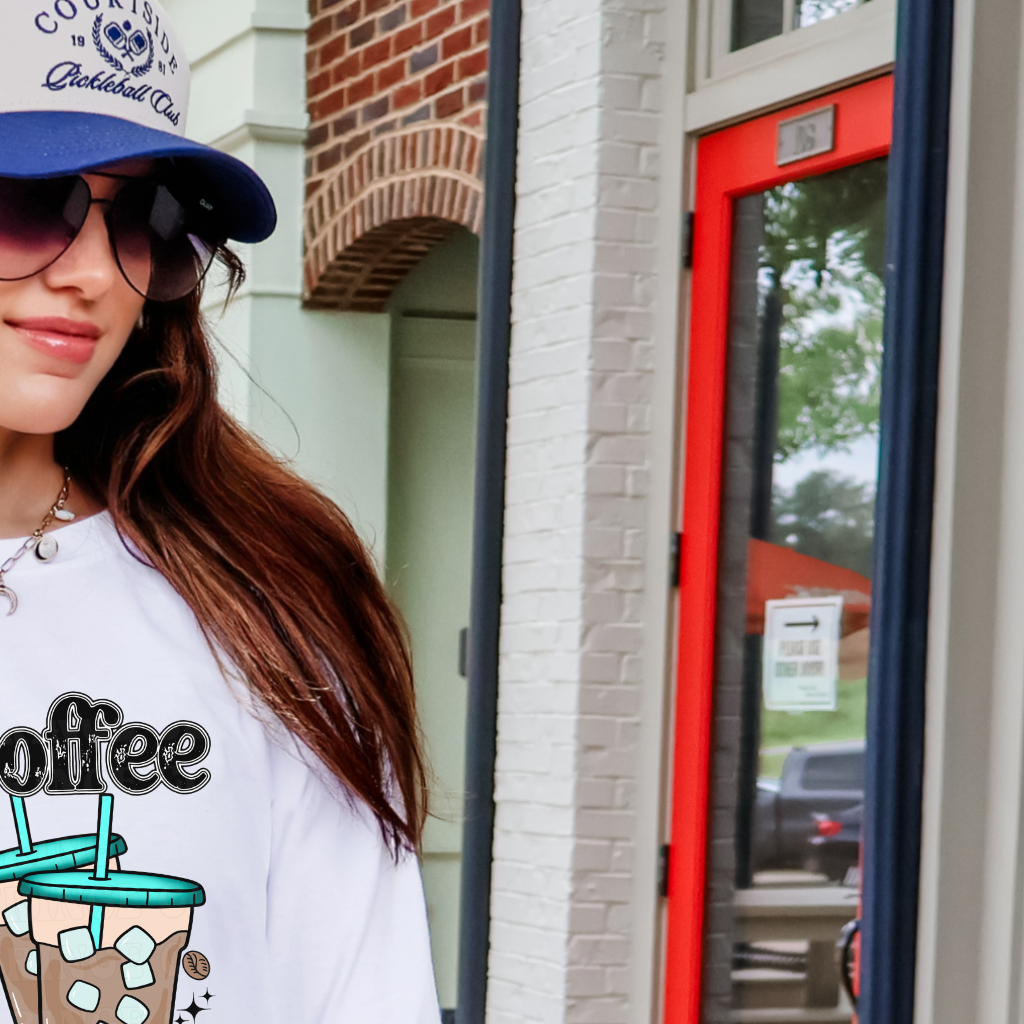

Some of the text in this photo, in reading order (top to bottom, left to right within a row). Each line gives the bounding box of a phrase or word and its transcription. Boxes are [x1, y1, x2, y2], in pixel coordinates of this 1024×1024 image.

[70, 35, 85, 47] 19
[41, 61, 179, 126] Pickleball Club
